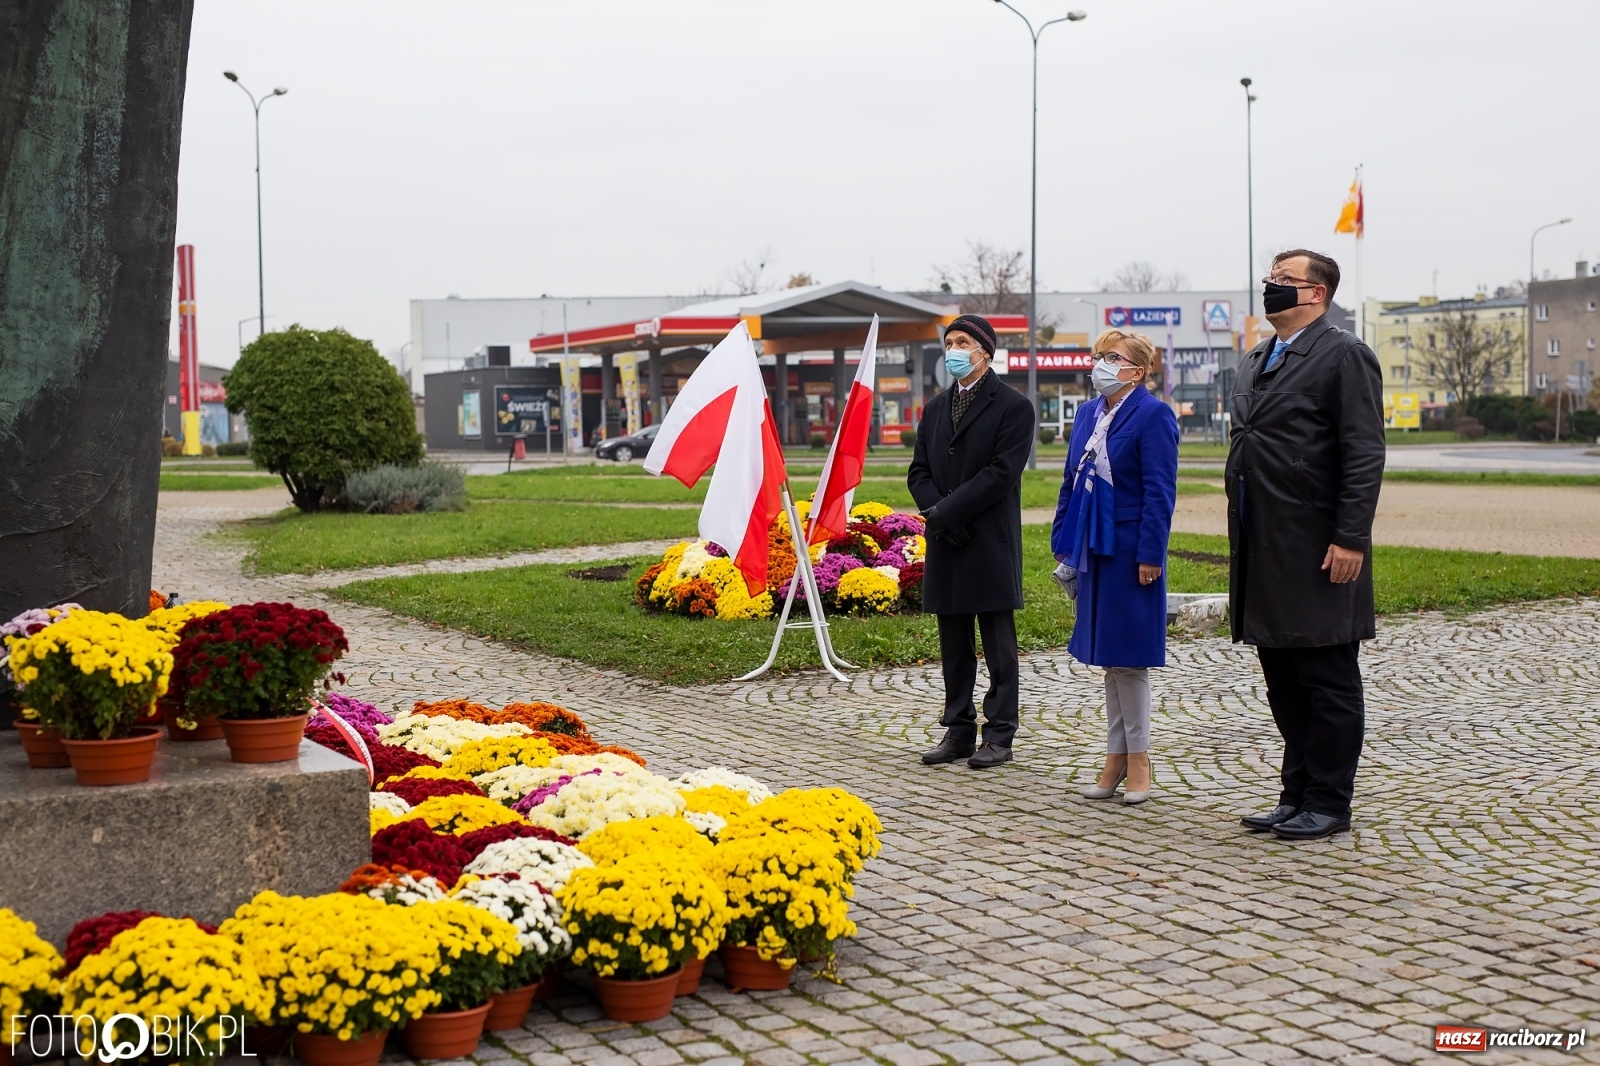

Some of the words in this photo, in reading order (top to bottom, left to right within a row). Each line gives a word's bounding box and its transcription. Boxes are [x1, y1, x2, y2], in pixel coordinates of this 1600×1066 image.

[1133, 310, 1179, 322] ŁAZIENI
[1009, 356, 1095, 367] RETAURAC
[507, 400, 546, 412] ŚWIEŻ
